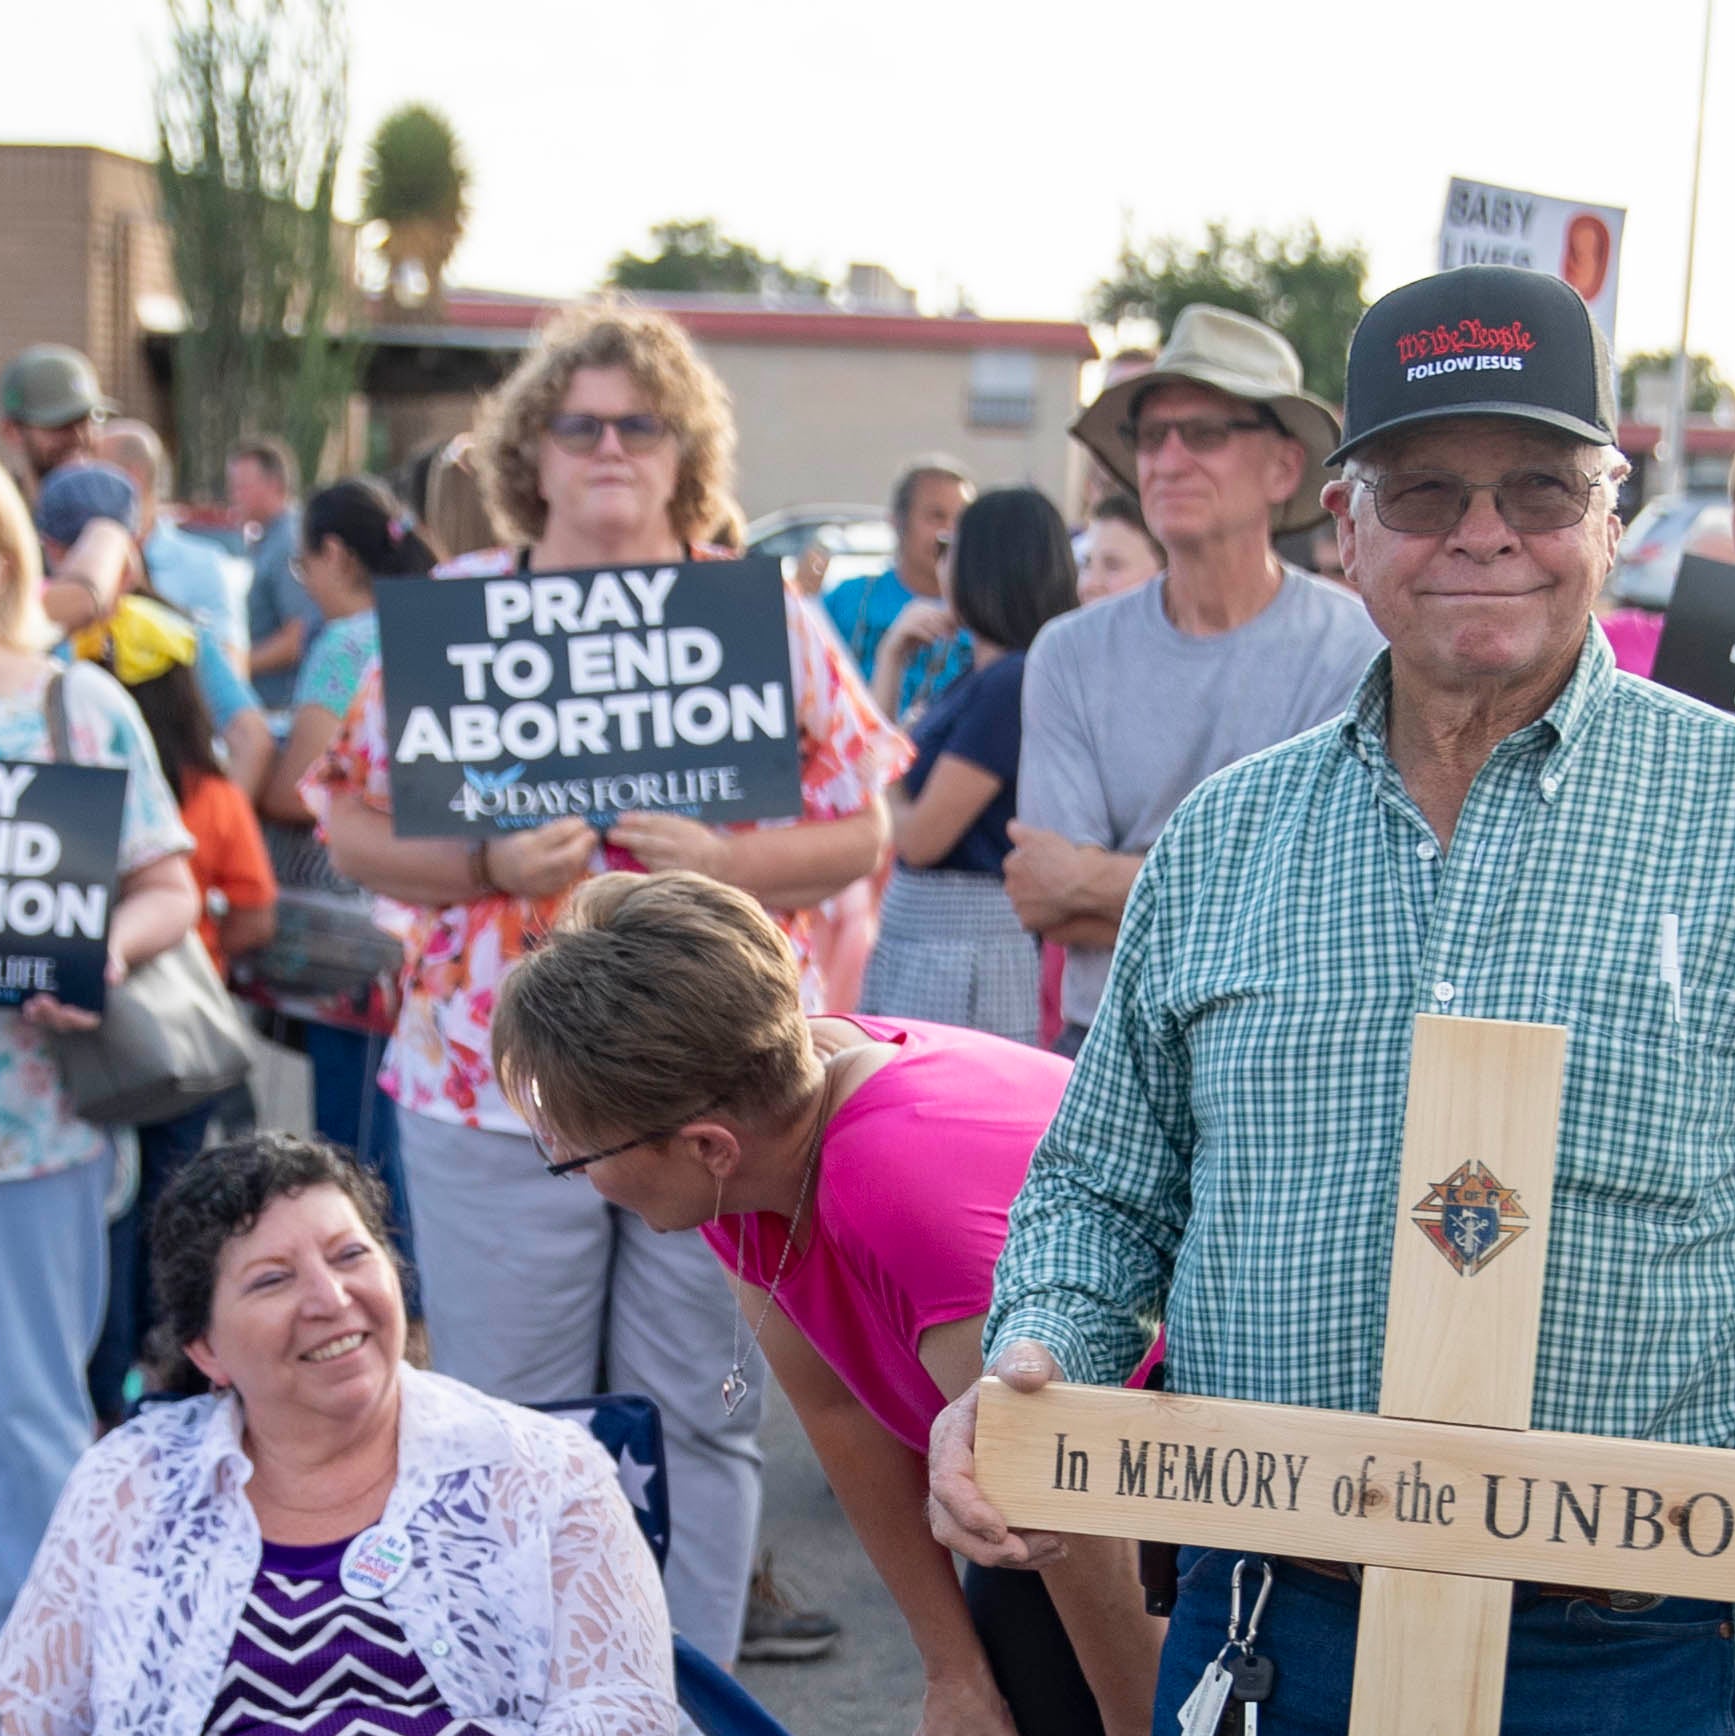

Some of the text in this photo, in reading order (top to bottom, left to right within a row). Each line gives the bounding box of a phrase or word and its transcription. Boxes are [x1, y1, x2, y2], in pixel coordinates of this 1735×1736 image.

[1406, 354, 1523, 382] FOLLOW JESUS
[1458, 318, 1537, 355] People
[484, 566, 679, 639] PRAY
[446, 626, 724, 701] TO END
[394, 681, 788, 764] ABORTION
[506, 778, 592, 818] DAYS
[592, 772, 670, 813] FOR
[668, 765, 745, 805] LIFE
[1052, 1432, 1090, 1494] In
[1115, 1438, 1310, 1512] MEMORY
[1331, 1454, 1378, 1519] of
[1394, 1460, 1457, 1527] the
